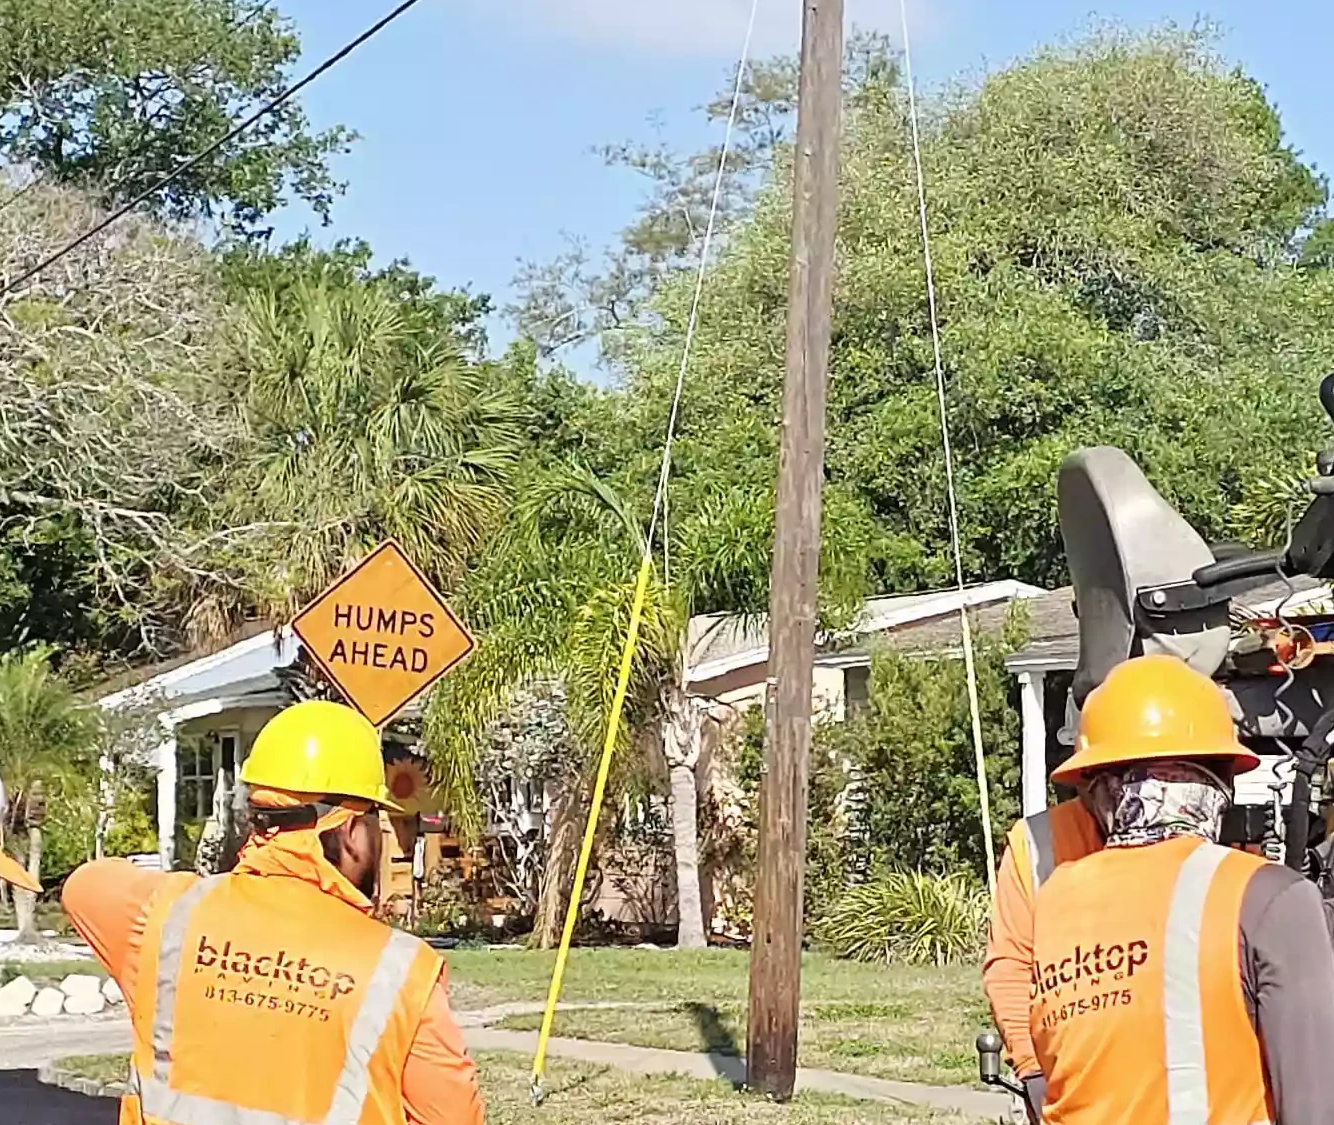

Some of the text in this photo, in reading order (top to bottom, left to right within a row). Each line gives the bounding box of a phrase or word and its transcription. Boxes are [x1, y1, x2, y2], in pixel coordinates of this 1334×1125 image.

[333, 603, 435, 638] HUMPS
[328, 638, 428, 673] AHEAD
[196, 935, 356, 1000] blacktop
[204, 984, 333, 1023] 813-675-9775
